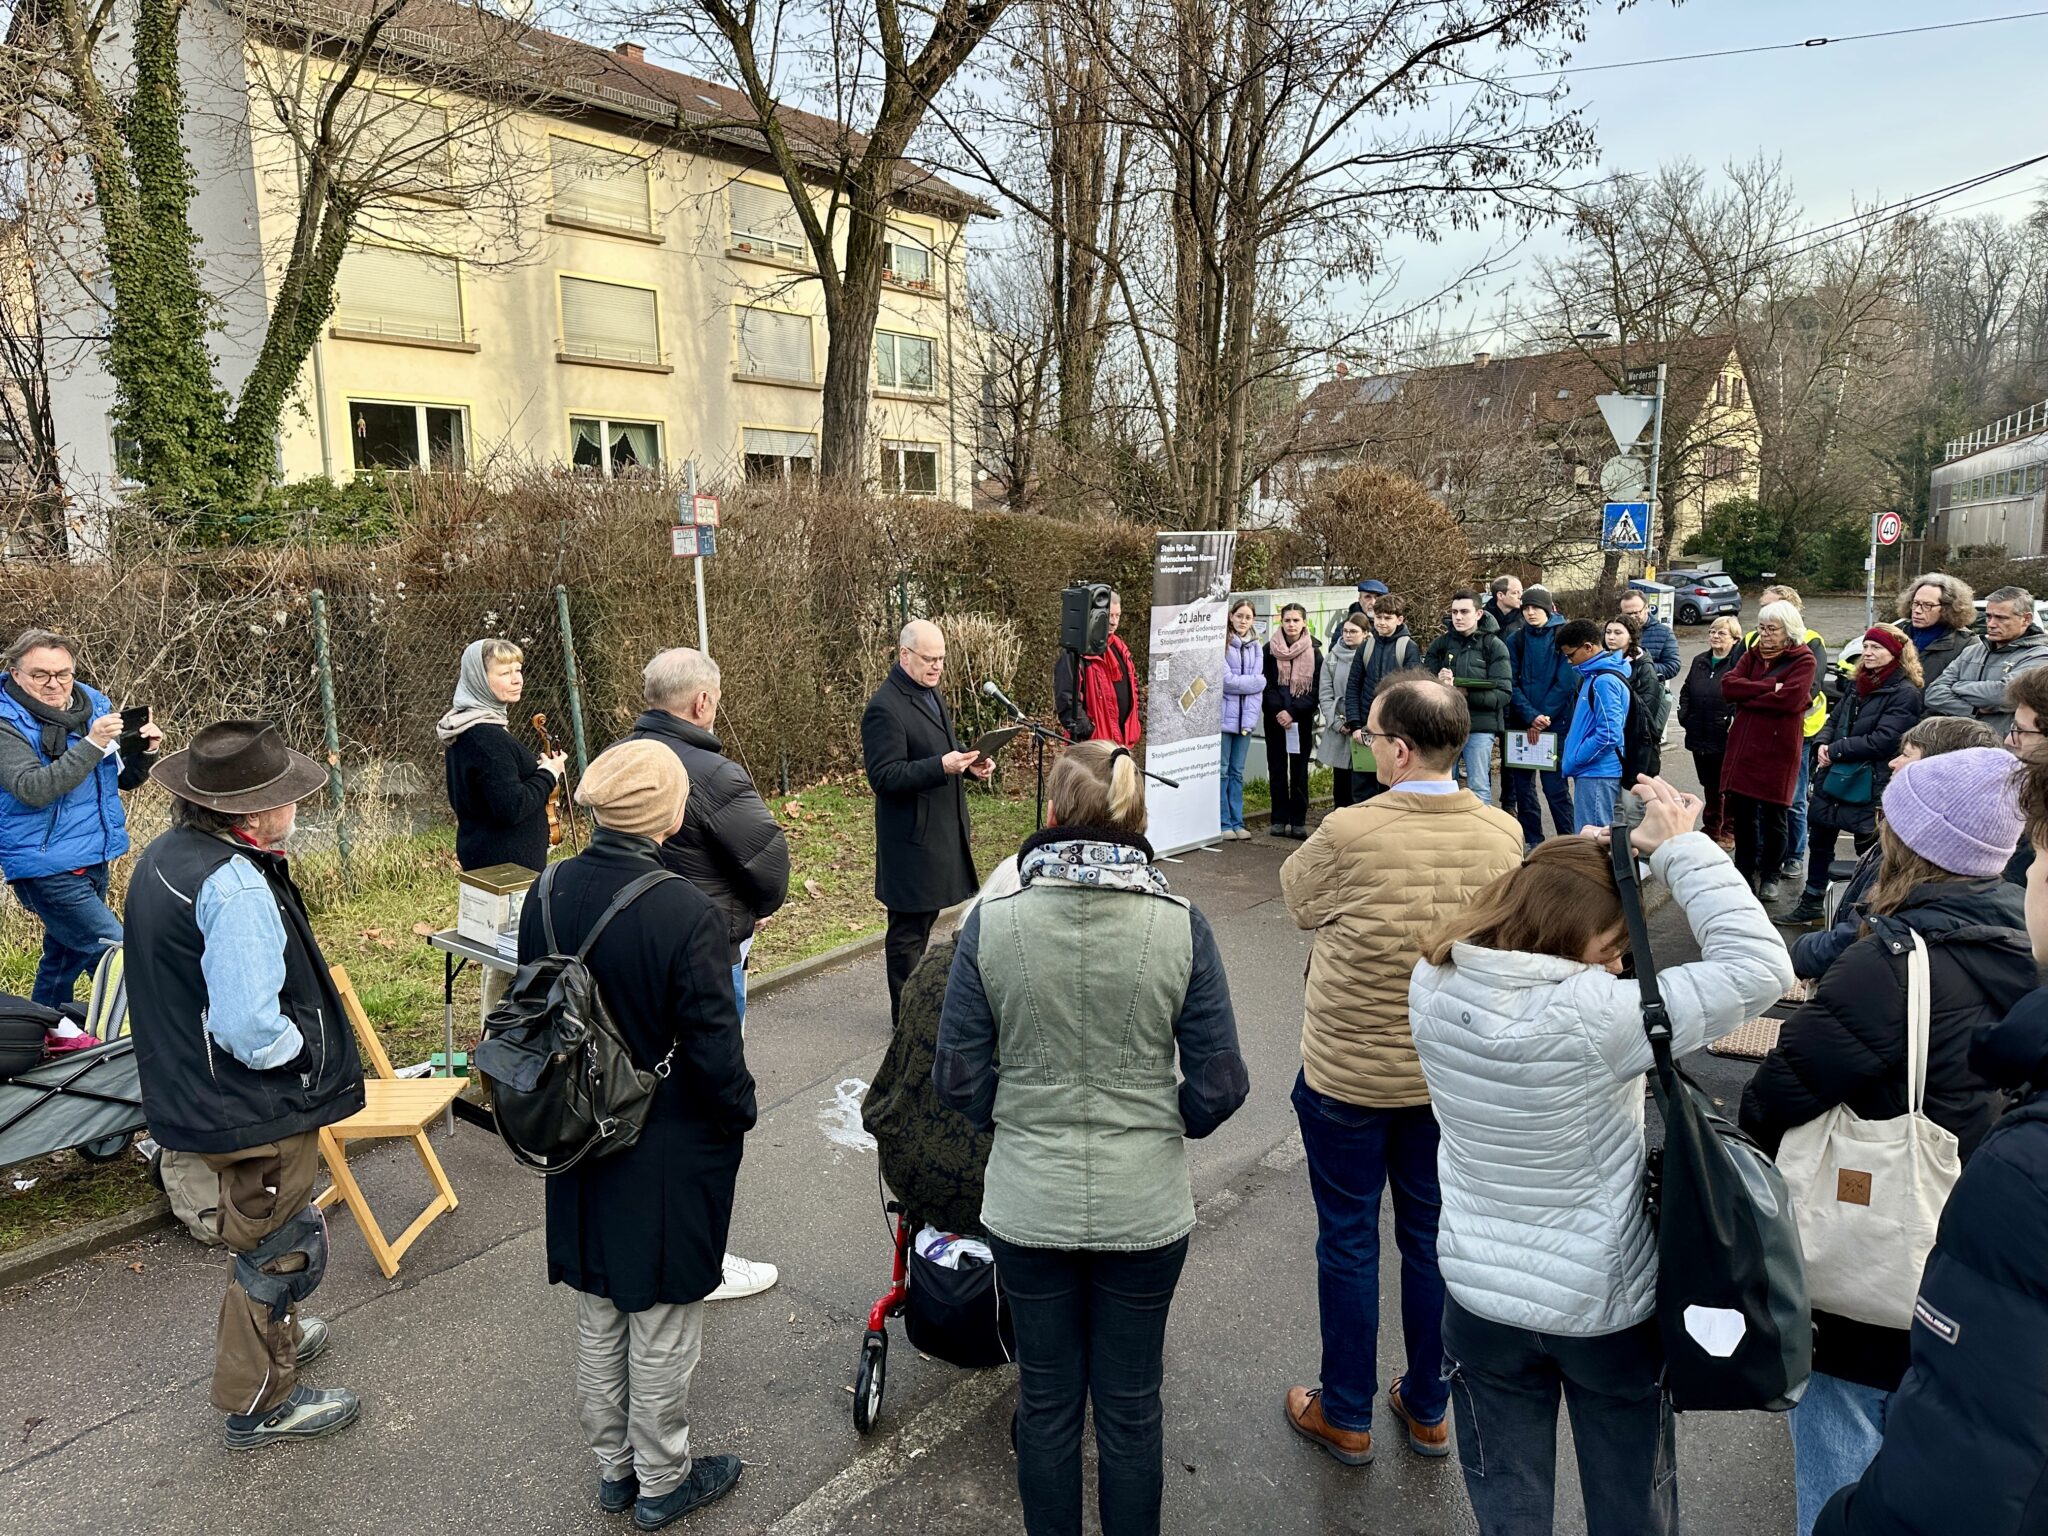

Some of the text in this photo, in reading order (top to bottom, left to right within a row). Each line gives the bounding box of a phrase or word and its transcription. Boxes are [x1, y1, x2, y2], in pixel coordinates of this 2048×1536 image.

[1883, 521, 1896, 535] 40
[1179, 610, 1211, 624] 20 Jahre
